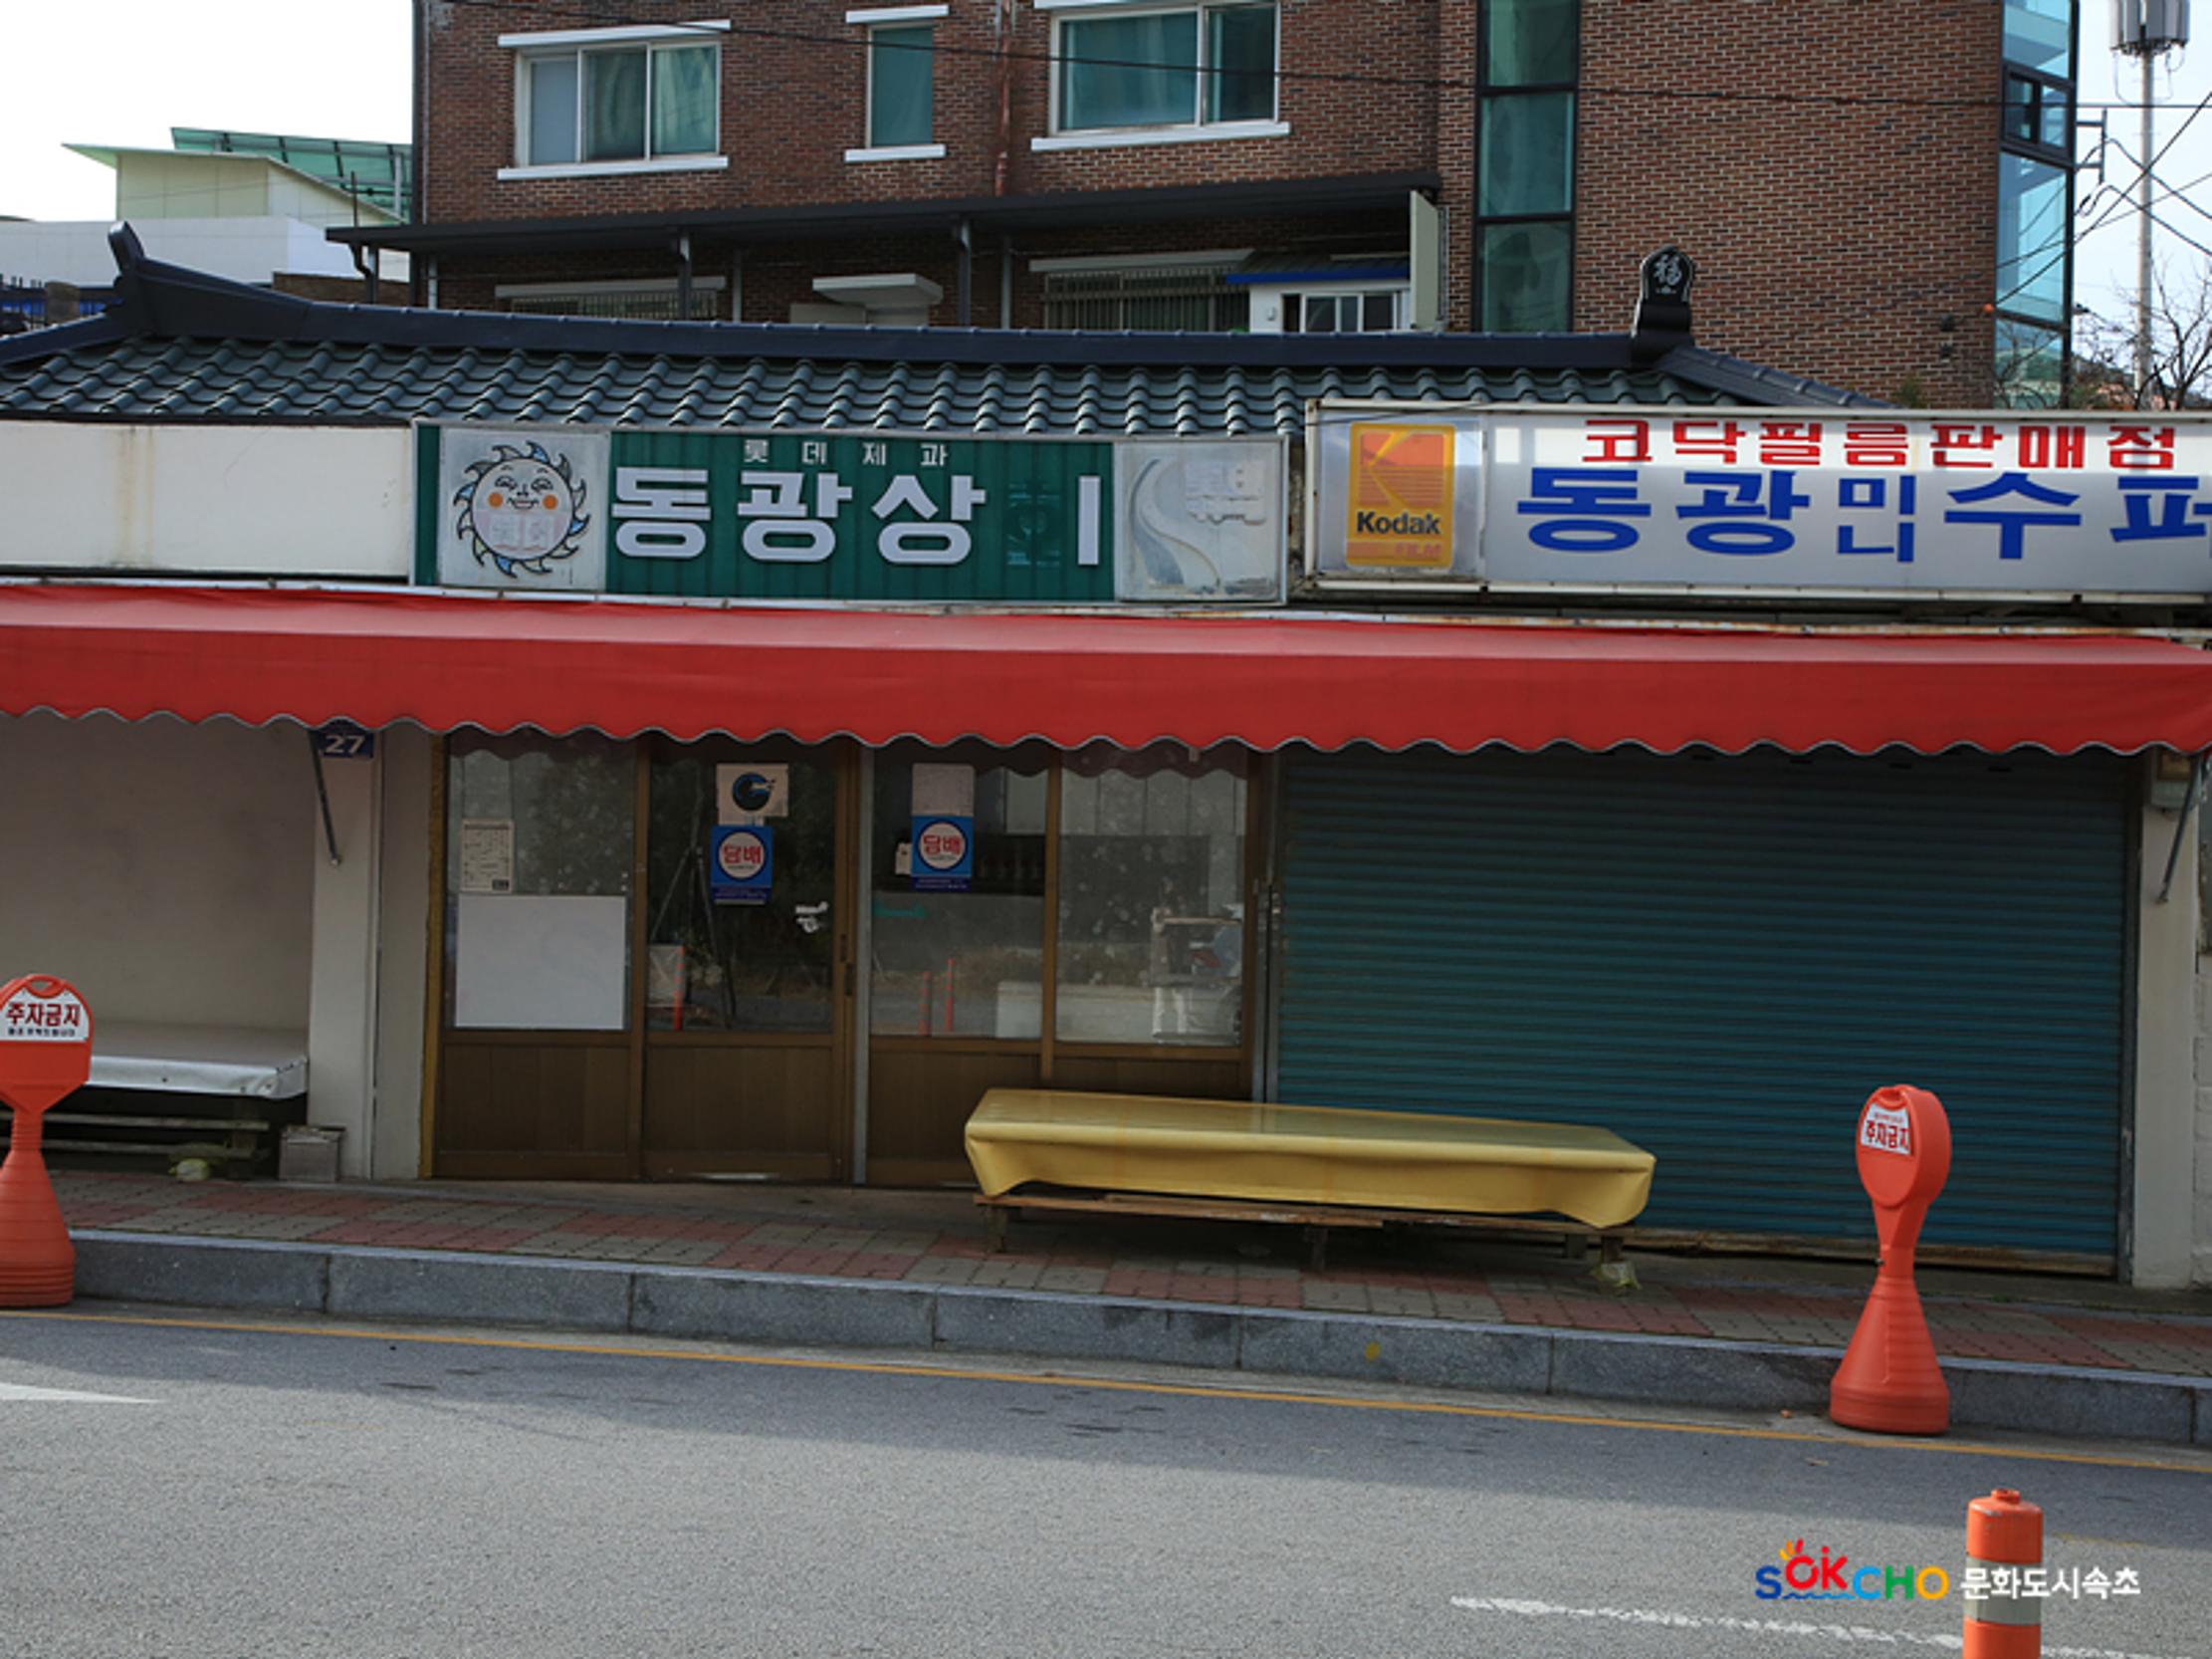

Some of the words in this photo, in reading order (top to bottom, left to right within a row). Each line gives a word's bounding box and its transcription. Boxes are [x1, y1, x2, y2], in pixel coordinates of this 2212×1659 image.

[1356, 511, 1441, 535] Kodak
[1395, 543, 1441, 559] FILM
[326, 734, 365, 754] 27
[723, 842, 762, 864] 담배
[922, 834, 963, 856] 담배
